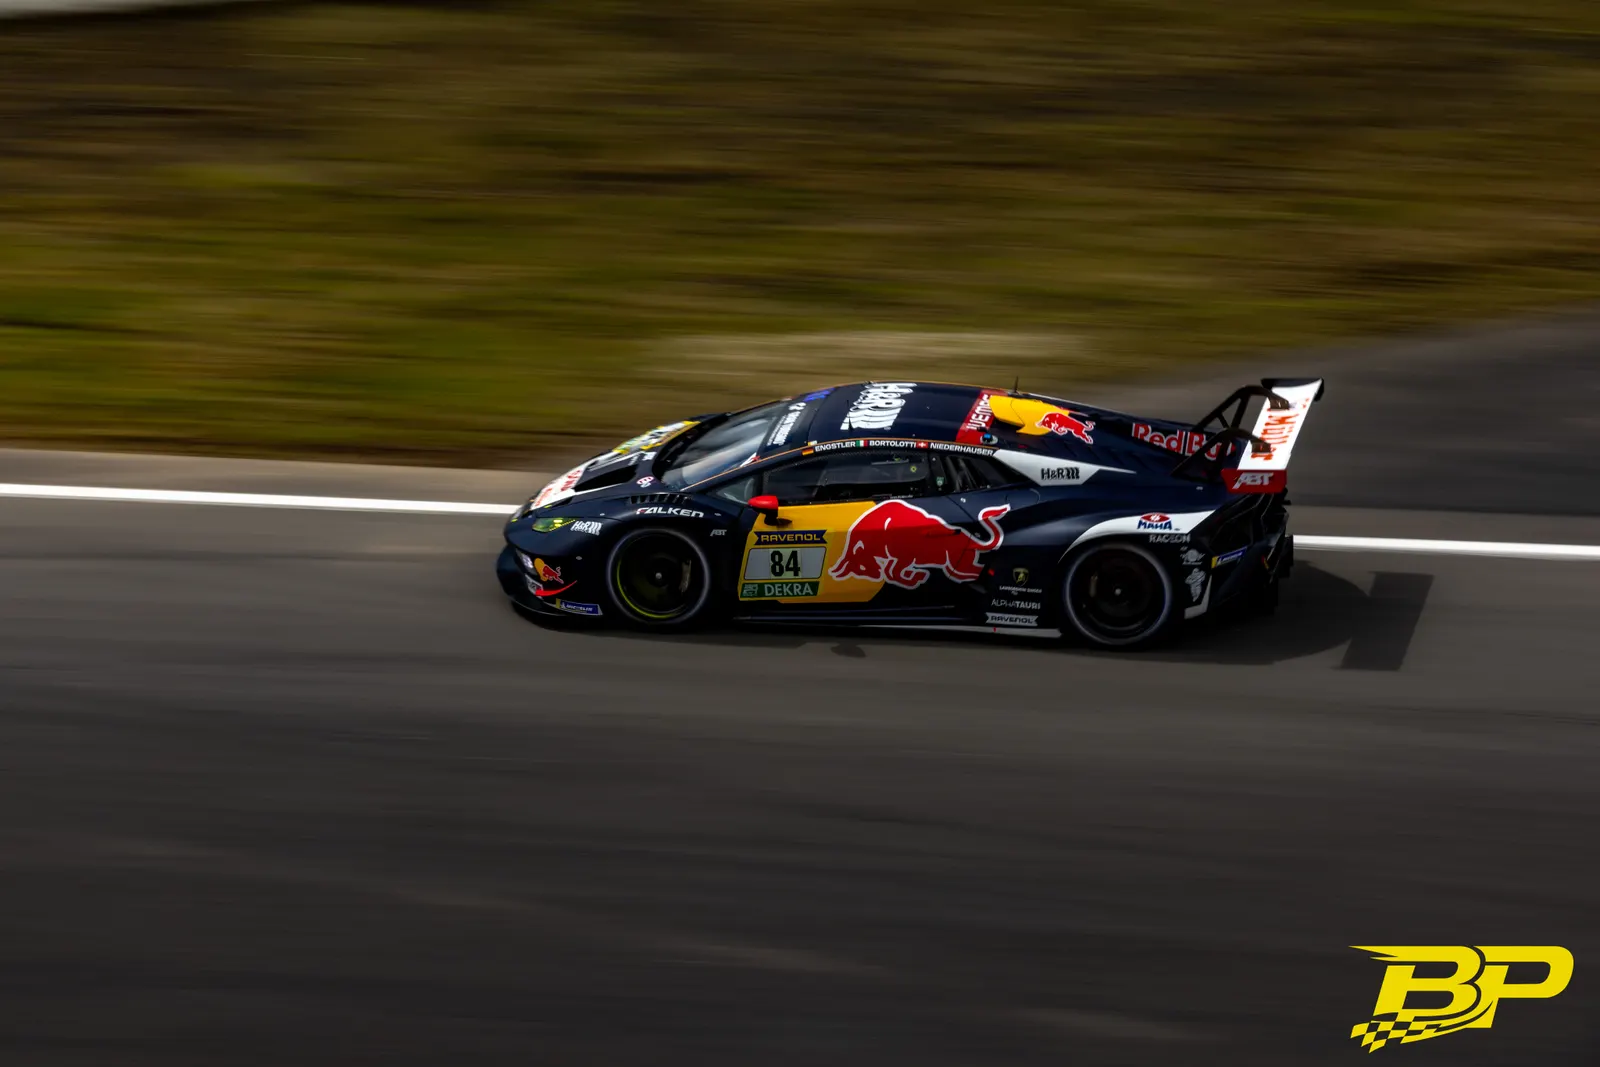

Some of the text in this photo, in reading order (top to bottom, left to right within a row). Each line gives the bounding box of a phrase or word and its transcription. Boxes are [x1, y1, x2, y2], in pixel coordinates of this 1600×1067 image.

[1132, 423, 1186, 456] Red
[1250, 412, 1300, 461] Müllr
[815, 440, 994, 456] ENGSTLER BORTOLOTTI NIEDERHAUSER
[1231, 472, 1274, 490] ABT
[636, 507, 704, 518] FALKEN
[1137, 519, 1173, 531] MAHA
[709, 529, 727, 537] ABT
[761, 533, 821, 542] RAVENOL
[770, 550, 801, 577] 84
[764, 583, 814, 596] DEKRA
[990, 615, 1034, 625] RAVENOL
